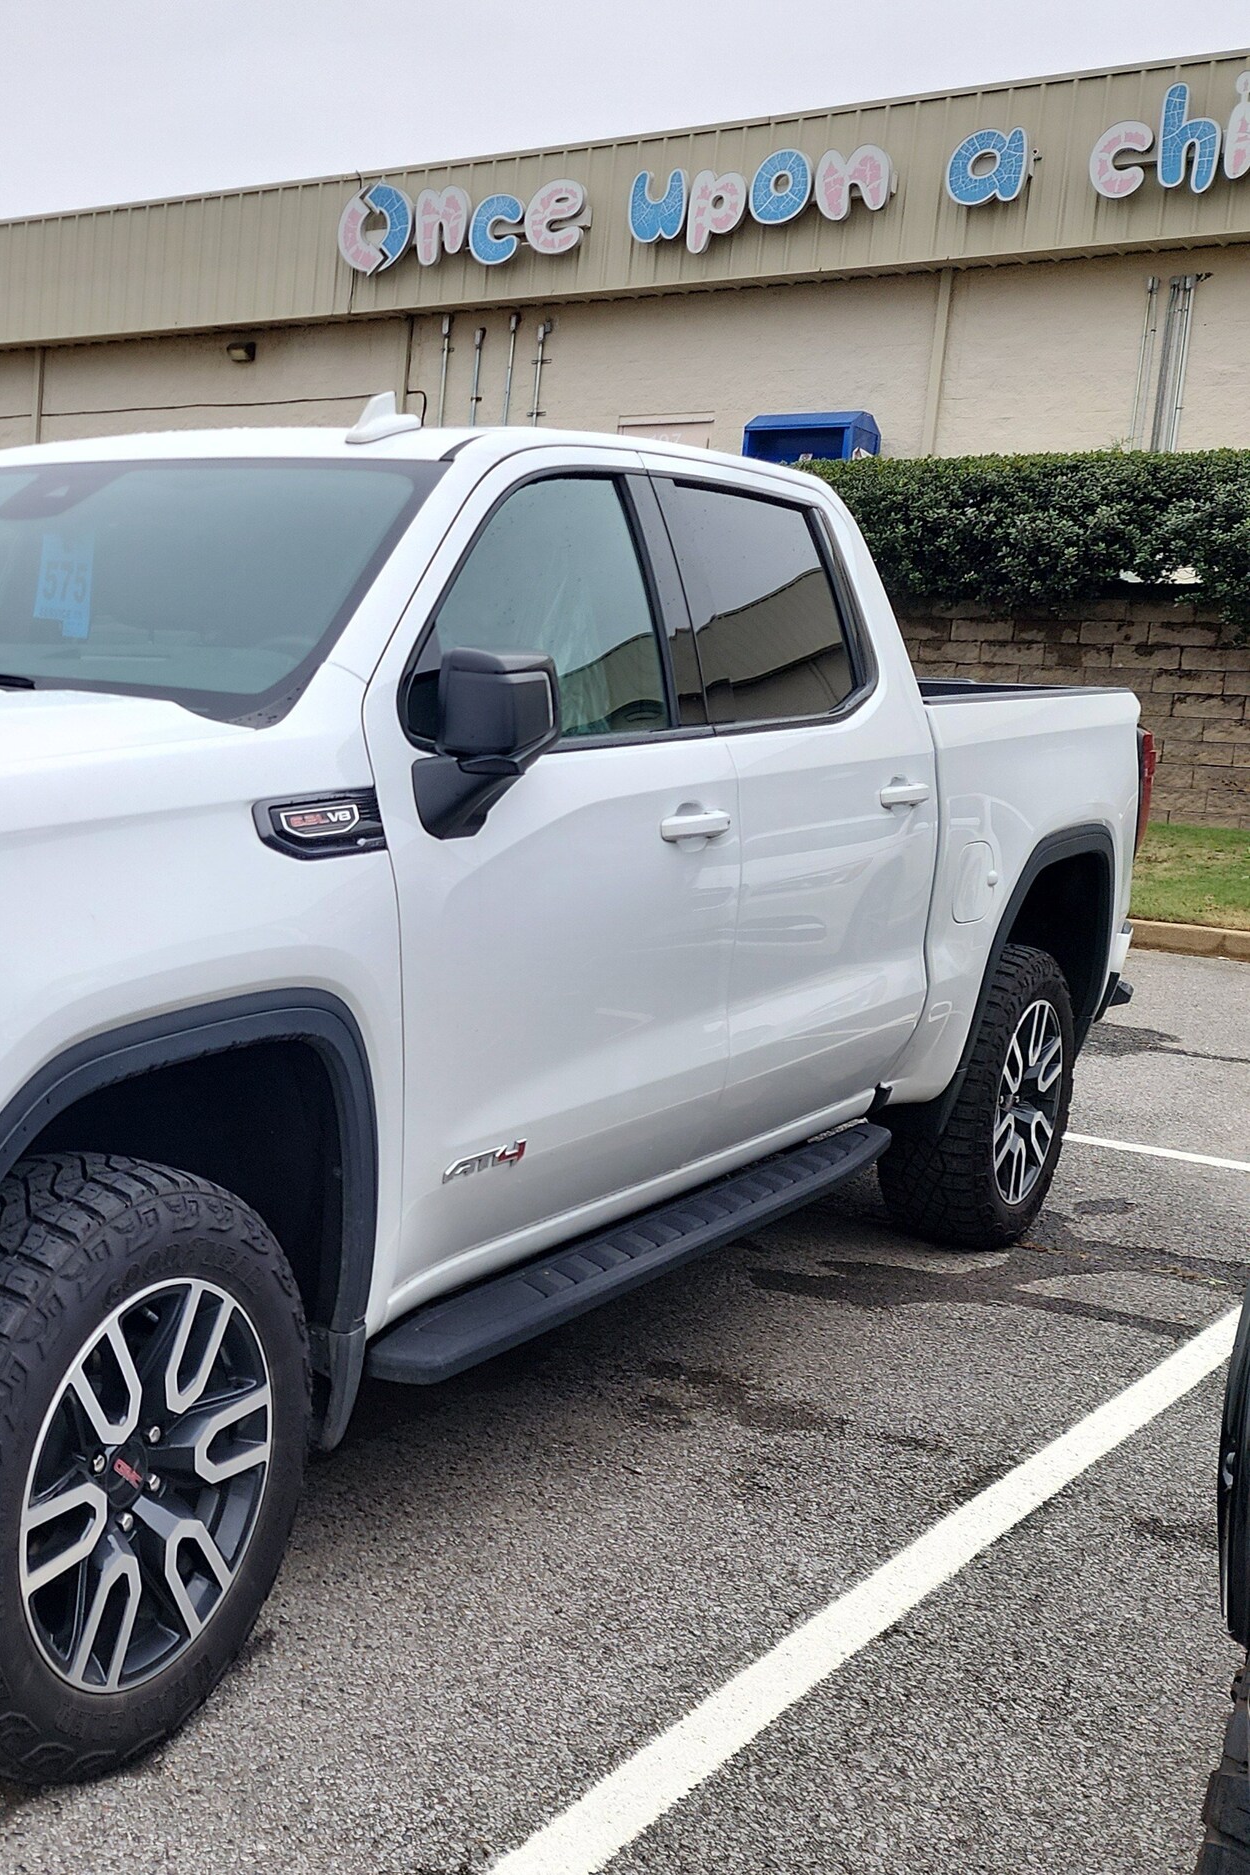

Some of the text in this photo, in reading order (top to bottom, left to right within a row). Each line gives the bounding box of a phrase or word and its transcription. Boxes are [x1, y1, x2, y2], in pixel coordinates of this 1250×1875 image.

[338, 172, 591, 276] Once
[627, 145, 896, 255] upon
[946, 126, 1033, 206] a
[42, 561, 88, 604] 575
[442, 1138, 527, 1184] AT4
